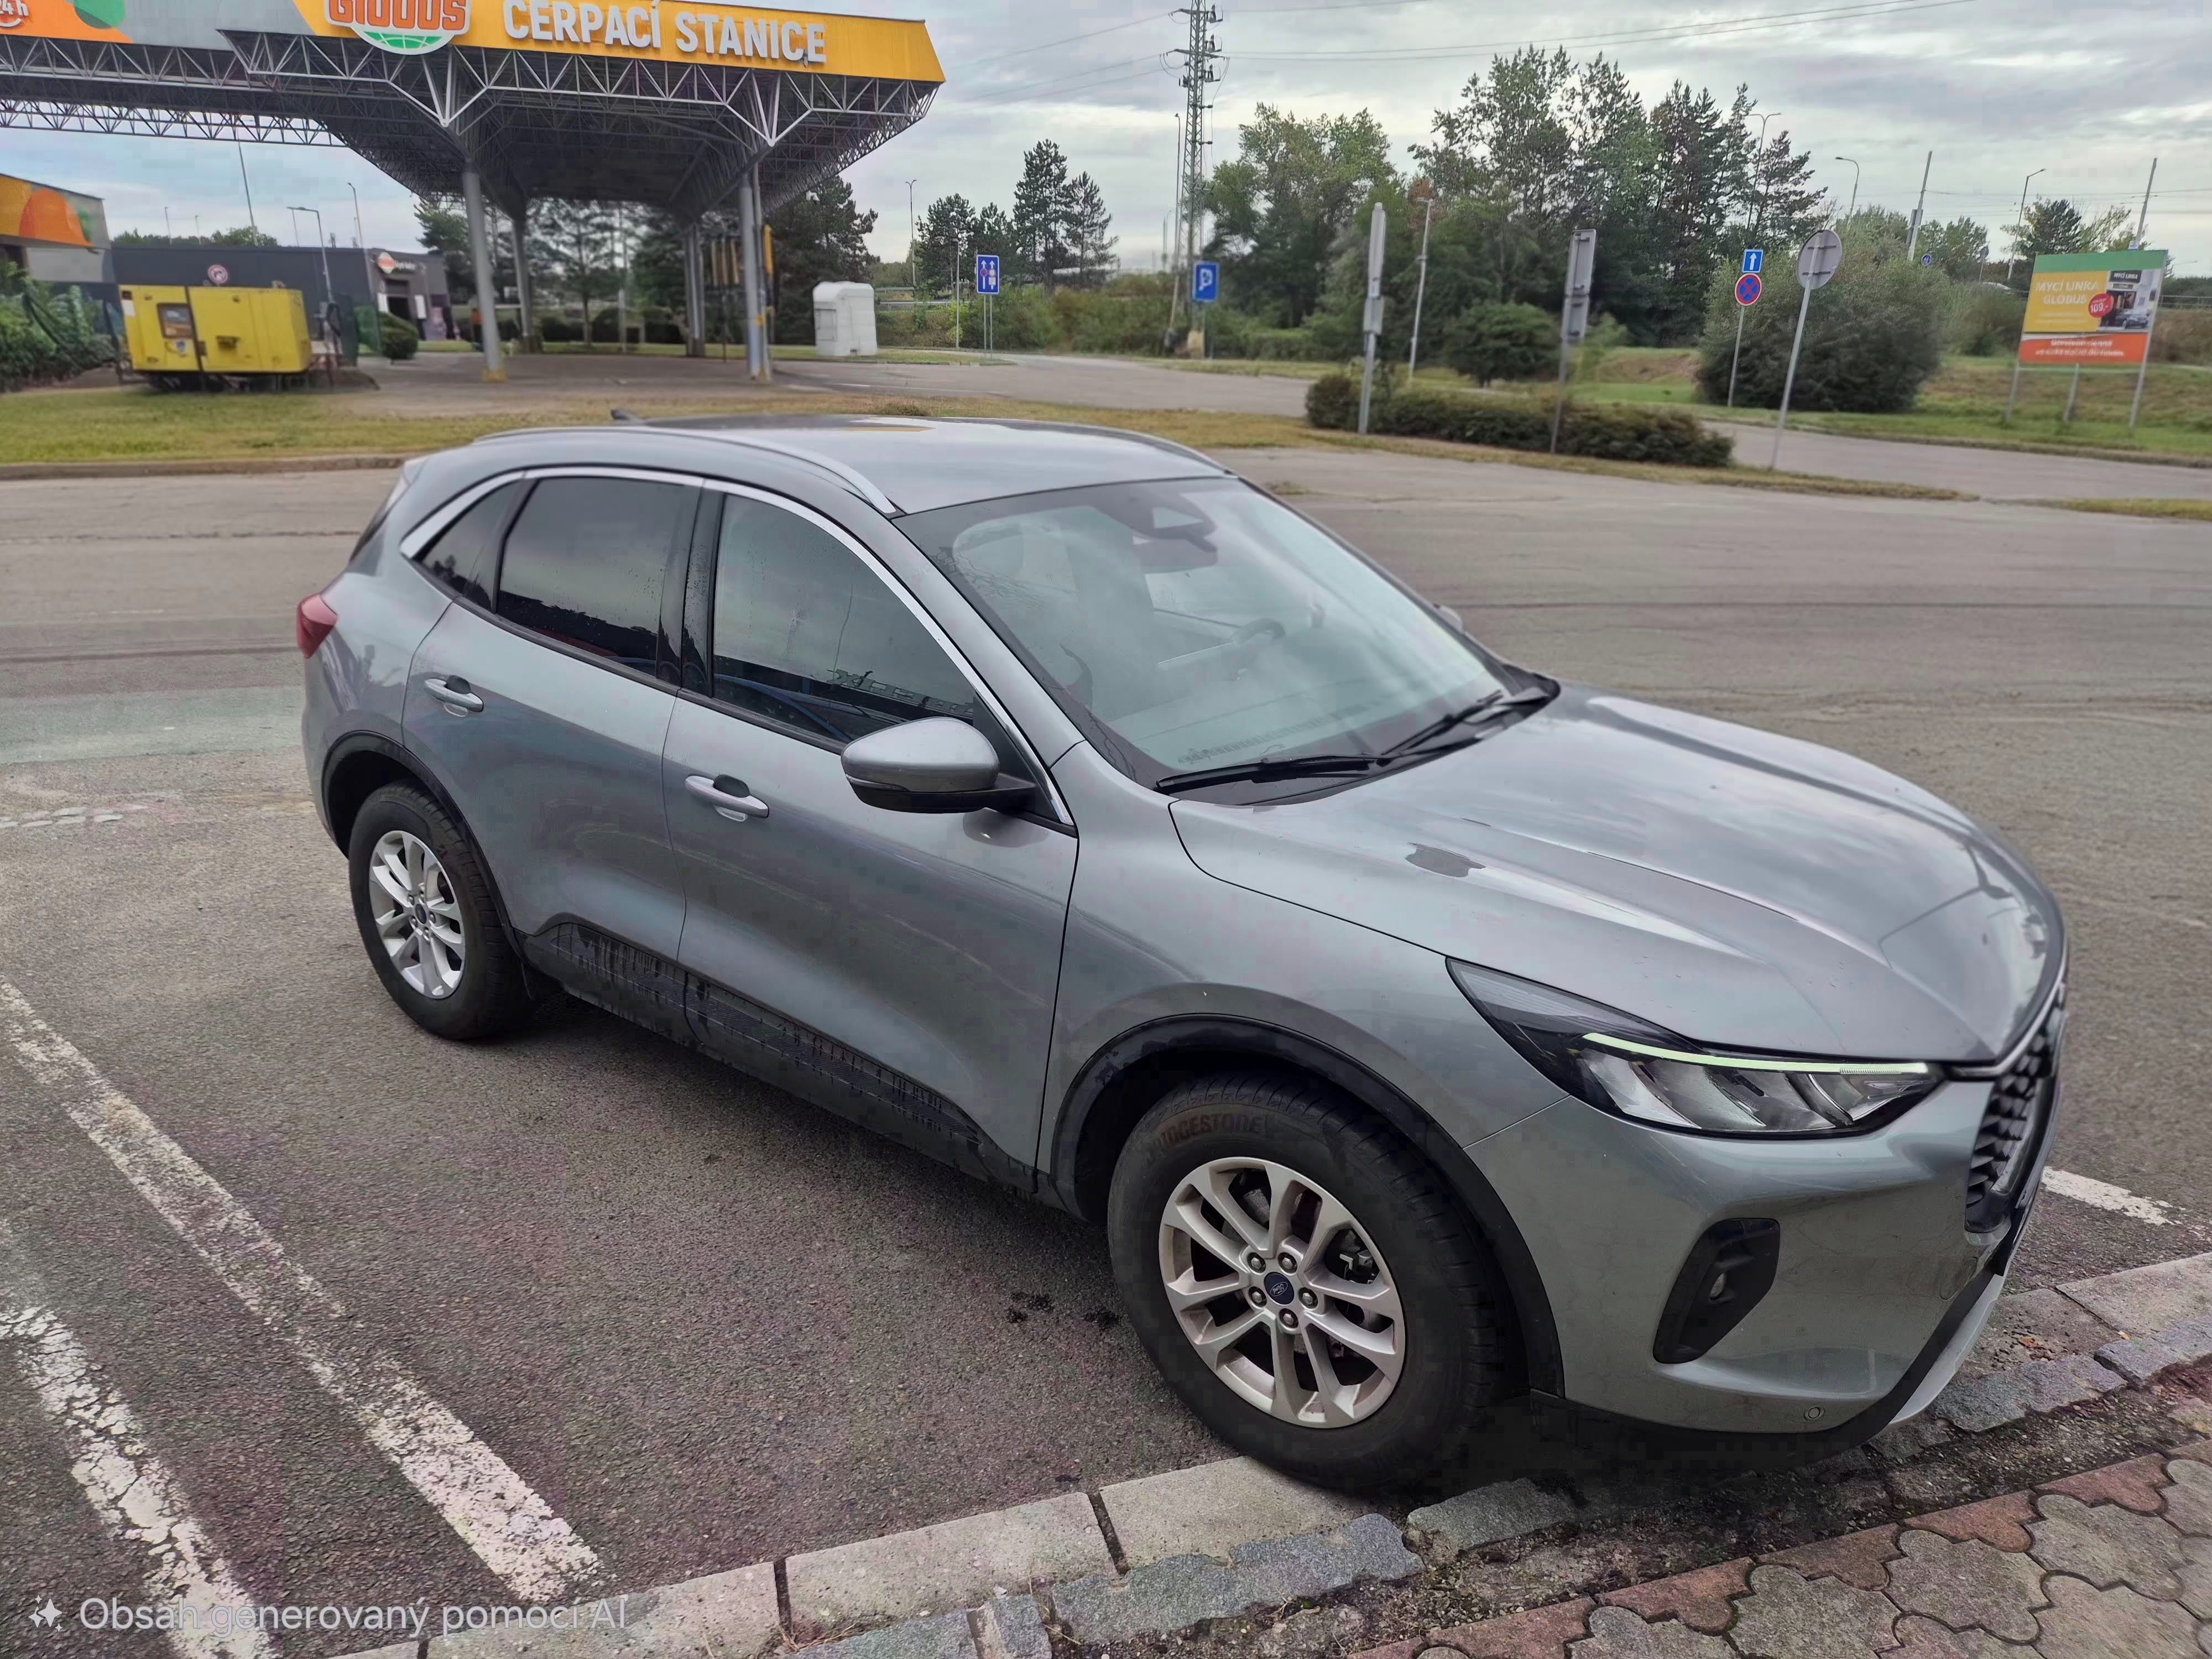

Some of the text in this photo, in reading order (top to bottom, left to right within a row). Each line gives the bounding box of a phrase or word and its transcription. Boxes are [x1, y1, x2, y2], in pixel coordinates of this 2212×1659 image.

[676, 12, 826, 62] STANICE
[2036, 279, 2099, 292] MYCÍ LINKA
[2043, 294, 2088, 305] GLOBUS
